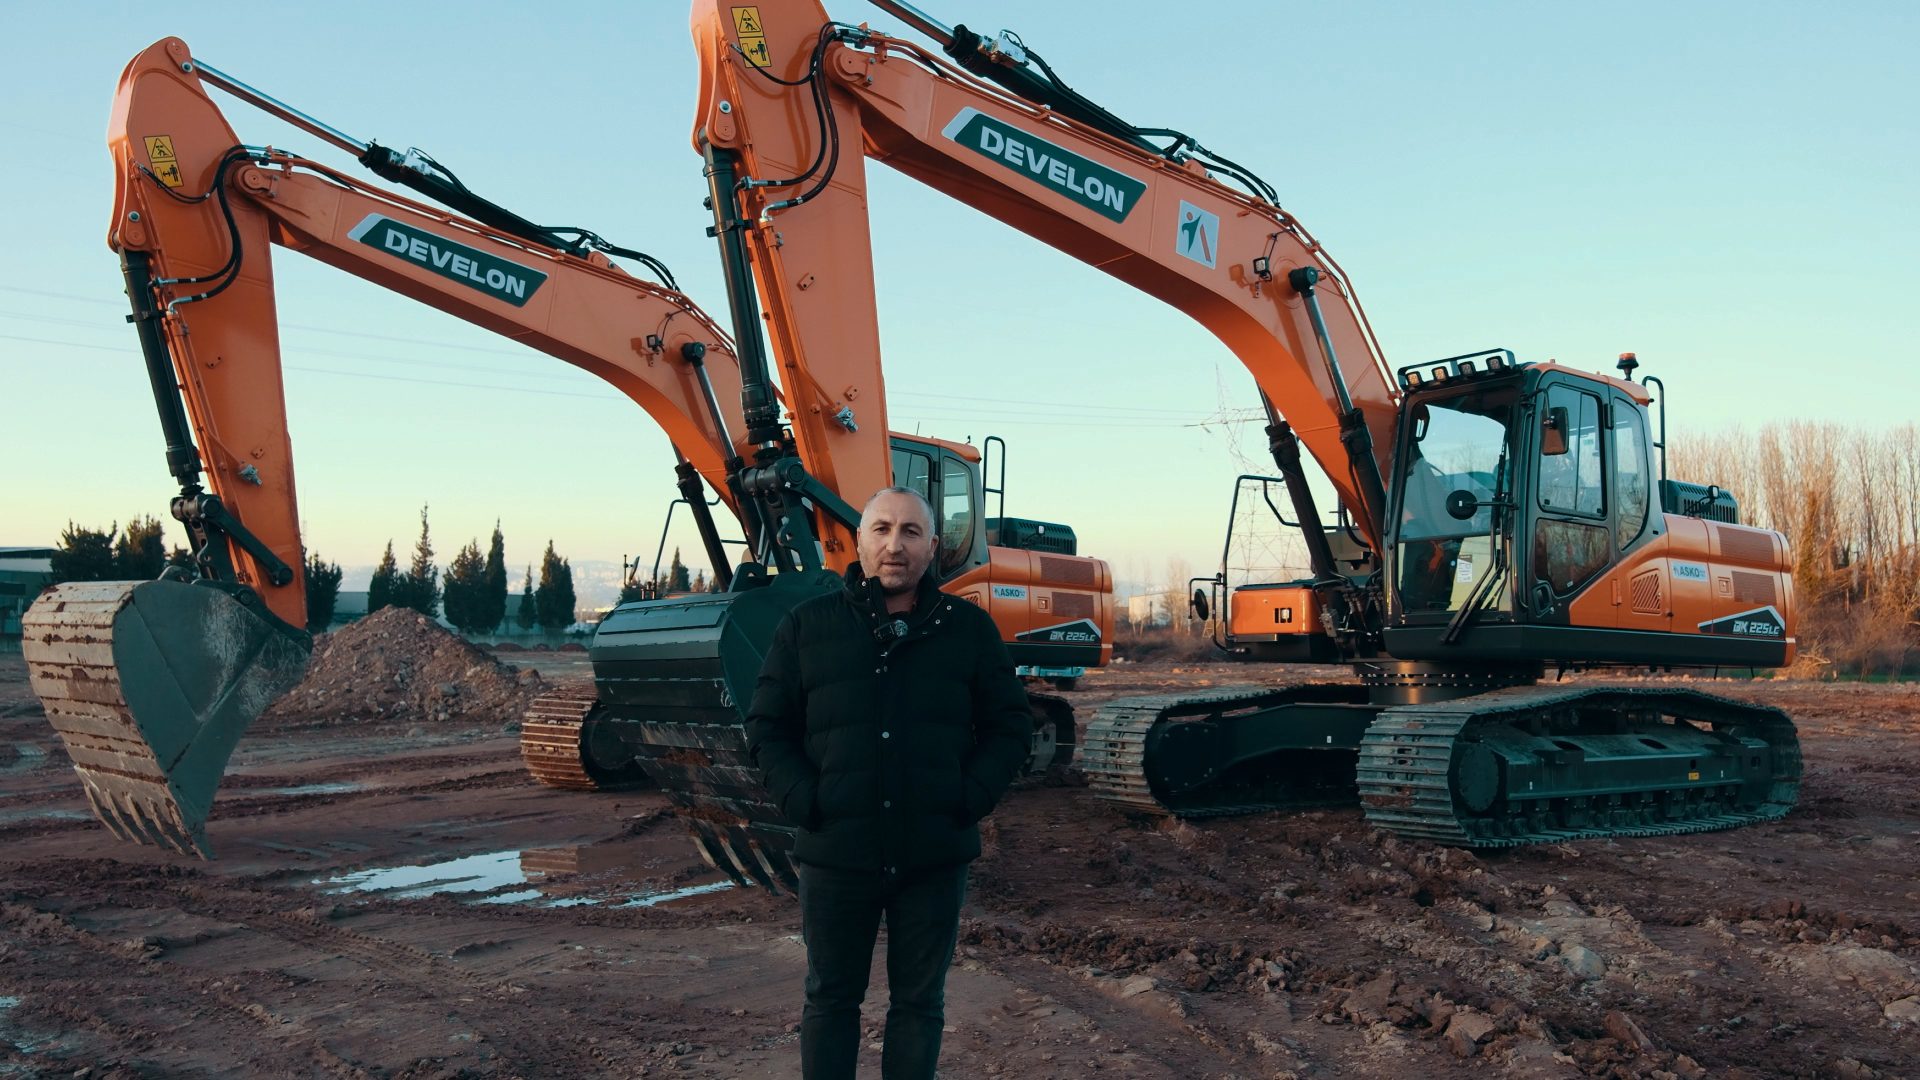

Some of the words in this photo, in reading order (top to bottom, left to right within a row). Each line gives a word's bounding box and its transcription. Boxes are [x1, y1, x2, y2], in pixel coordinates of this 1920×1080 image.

[980, 126, 1124, 212] DEVELON
[384, 228, 526, 298] DEVELON
[1679, 566, 1700, 577] ASKO
[1000, 588, 1020, 597] ASKO
